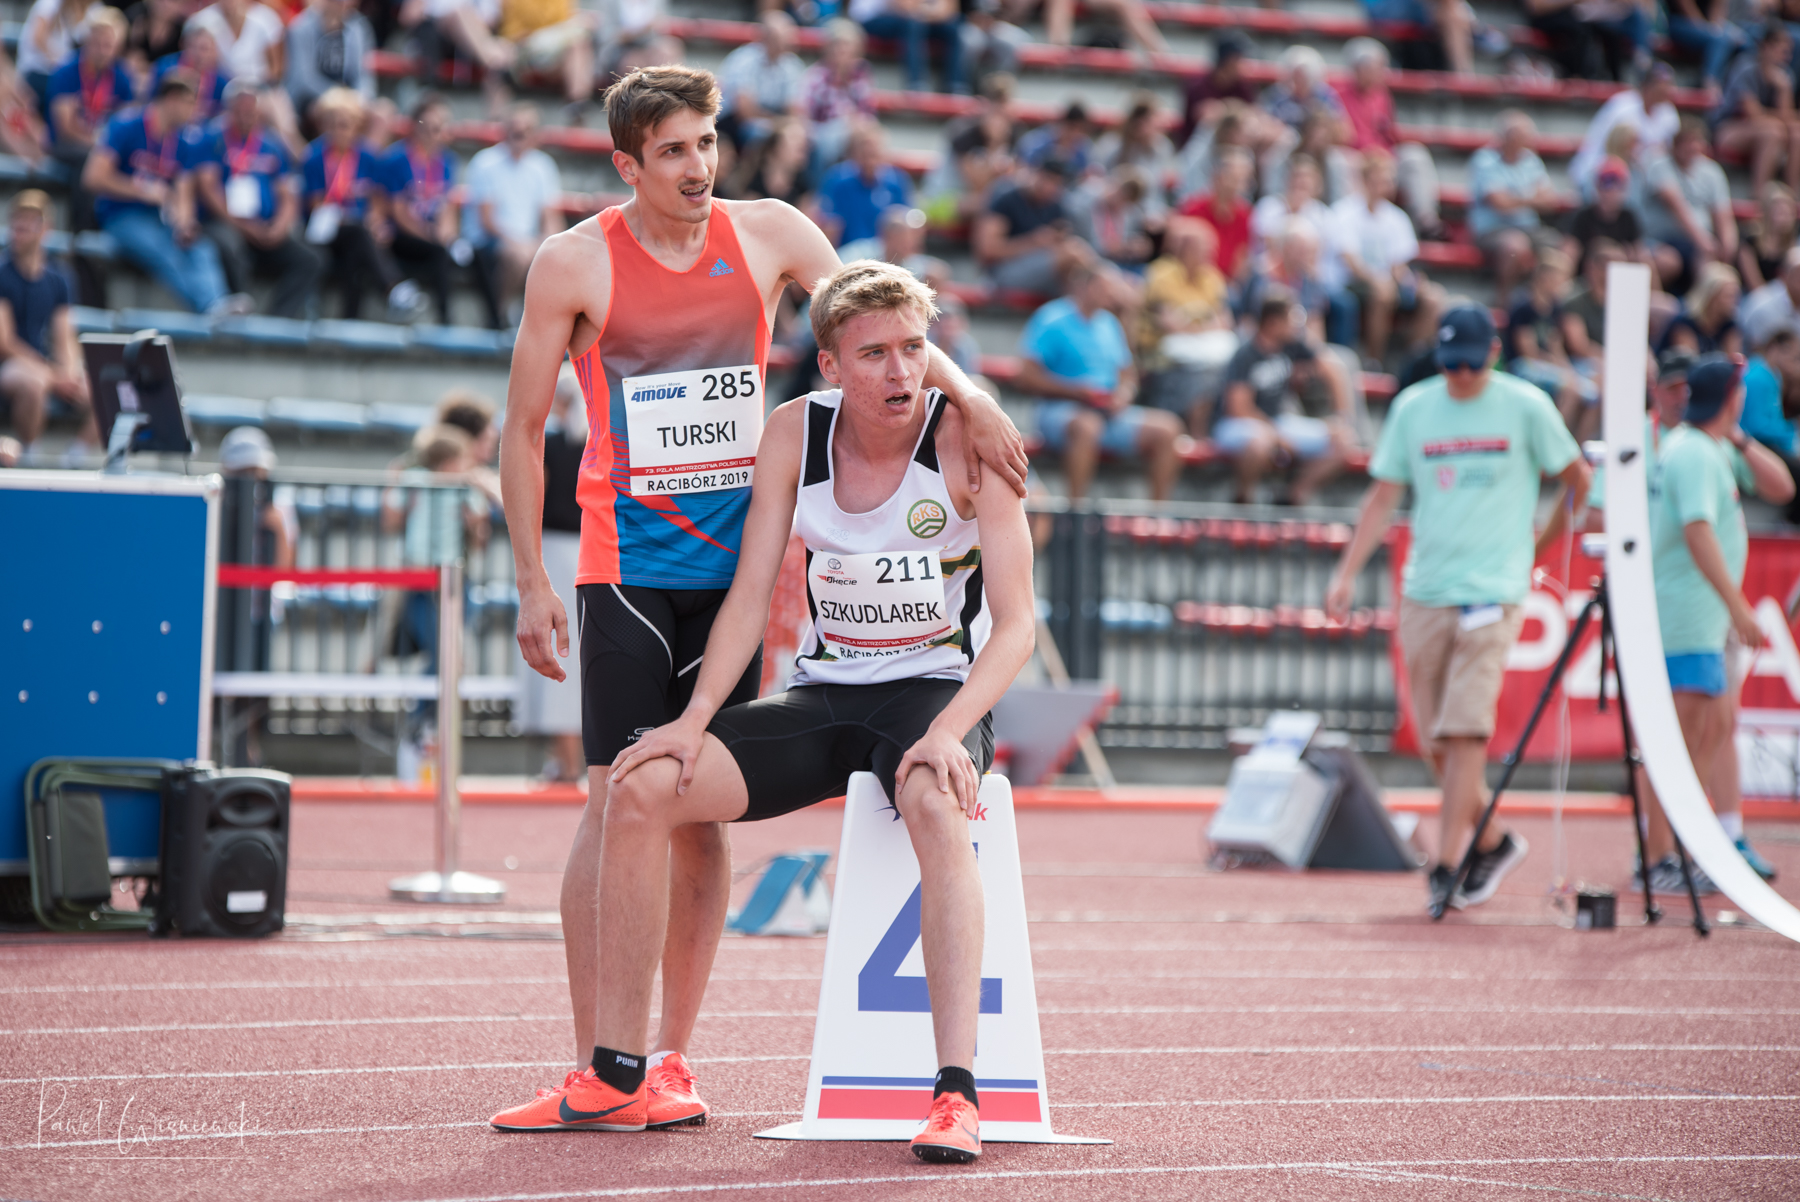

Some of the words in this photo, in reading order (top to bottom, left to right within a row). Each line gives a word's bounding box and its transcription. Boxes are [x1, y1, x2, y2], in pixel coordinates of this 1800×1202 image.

[709, 268, 734, 277] adidas
[631, 386, 687, 402] 4MOVE
[702, 371, 756, 401] 285
[657, 420, 737, 448] TURSKI
[674, 462, 718, 472] MISTRZOSTWA
[719, 460, 739, 468] POLSKI
[648, 473, 716, 491] RACIBÓRZ
[720, 471, 748, 486] 2019
[912, 504, 940, 525] RKS
[875, 556, 935, 584] 211
[820, 600, 942, 624] SZKUDLAREK
[615, 1055, 639, 1068] PUMA
